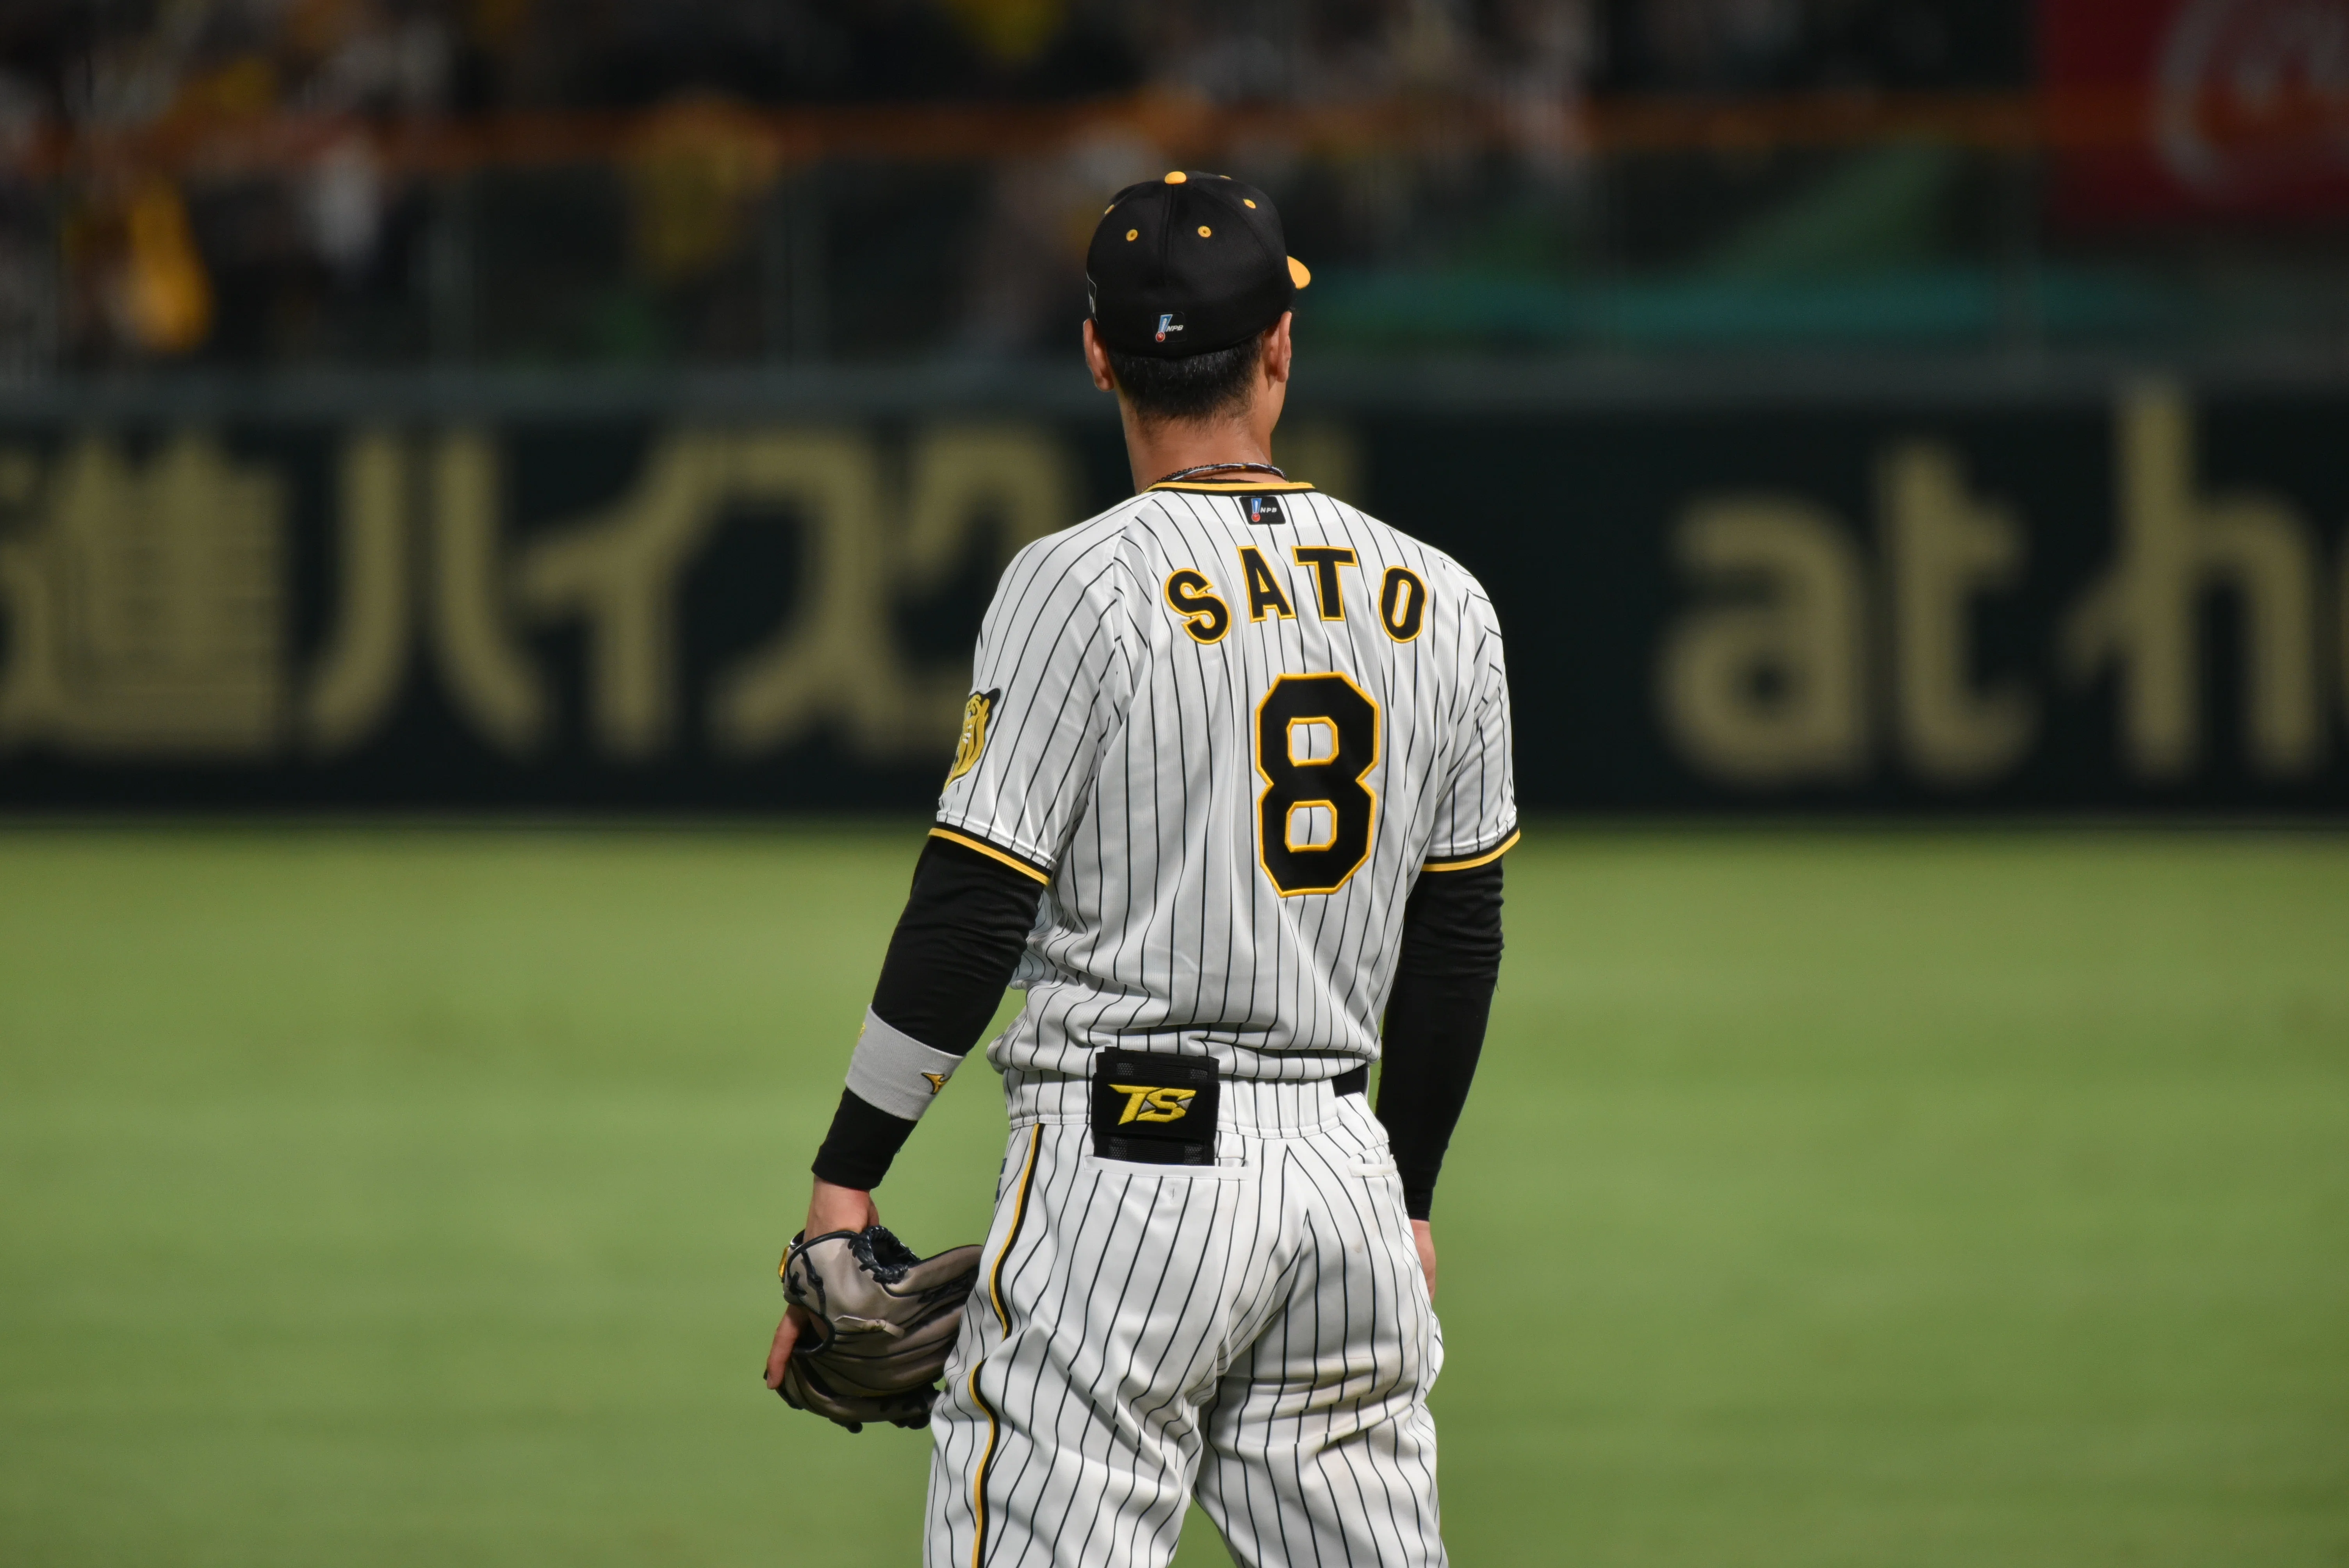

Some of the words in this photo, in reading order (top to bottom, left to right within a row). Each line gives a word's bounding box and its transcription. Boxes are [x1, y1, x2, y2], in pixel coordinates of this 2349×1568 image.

[1165, 545, 1428, 645] SATO
[1255, 671, 1381, 898] 8
[1107, 1084, 1197, 1126] TS
